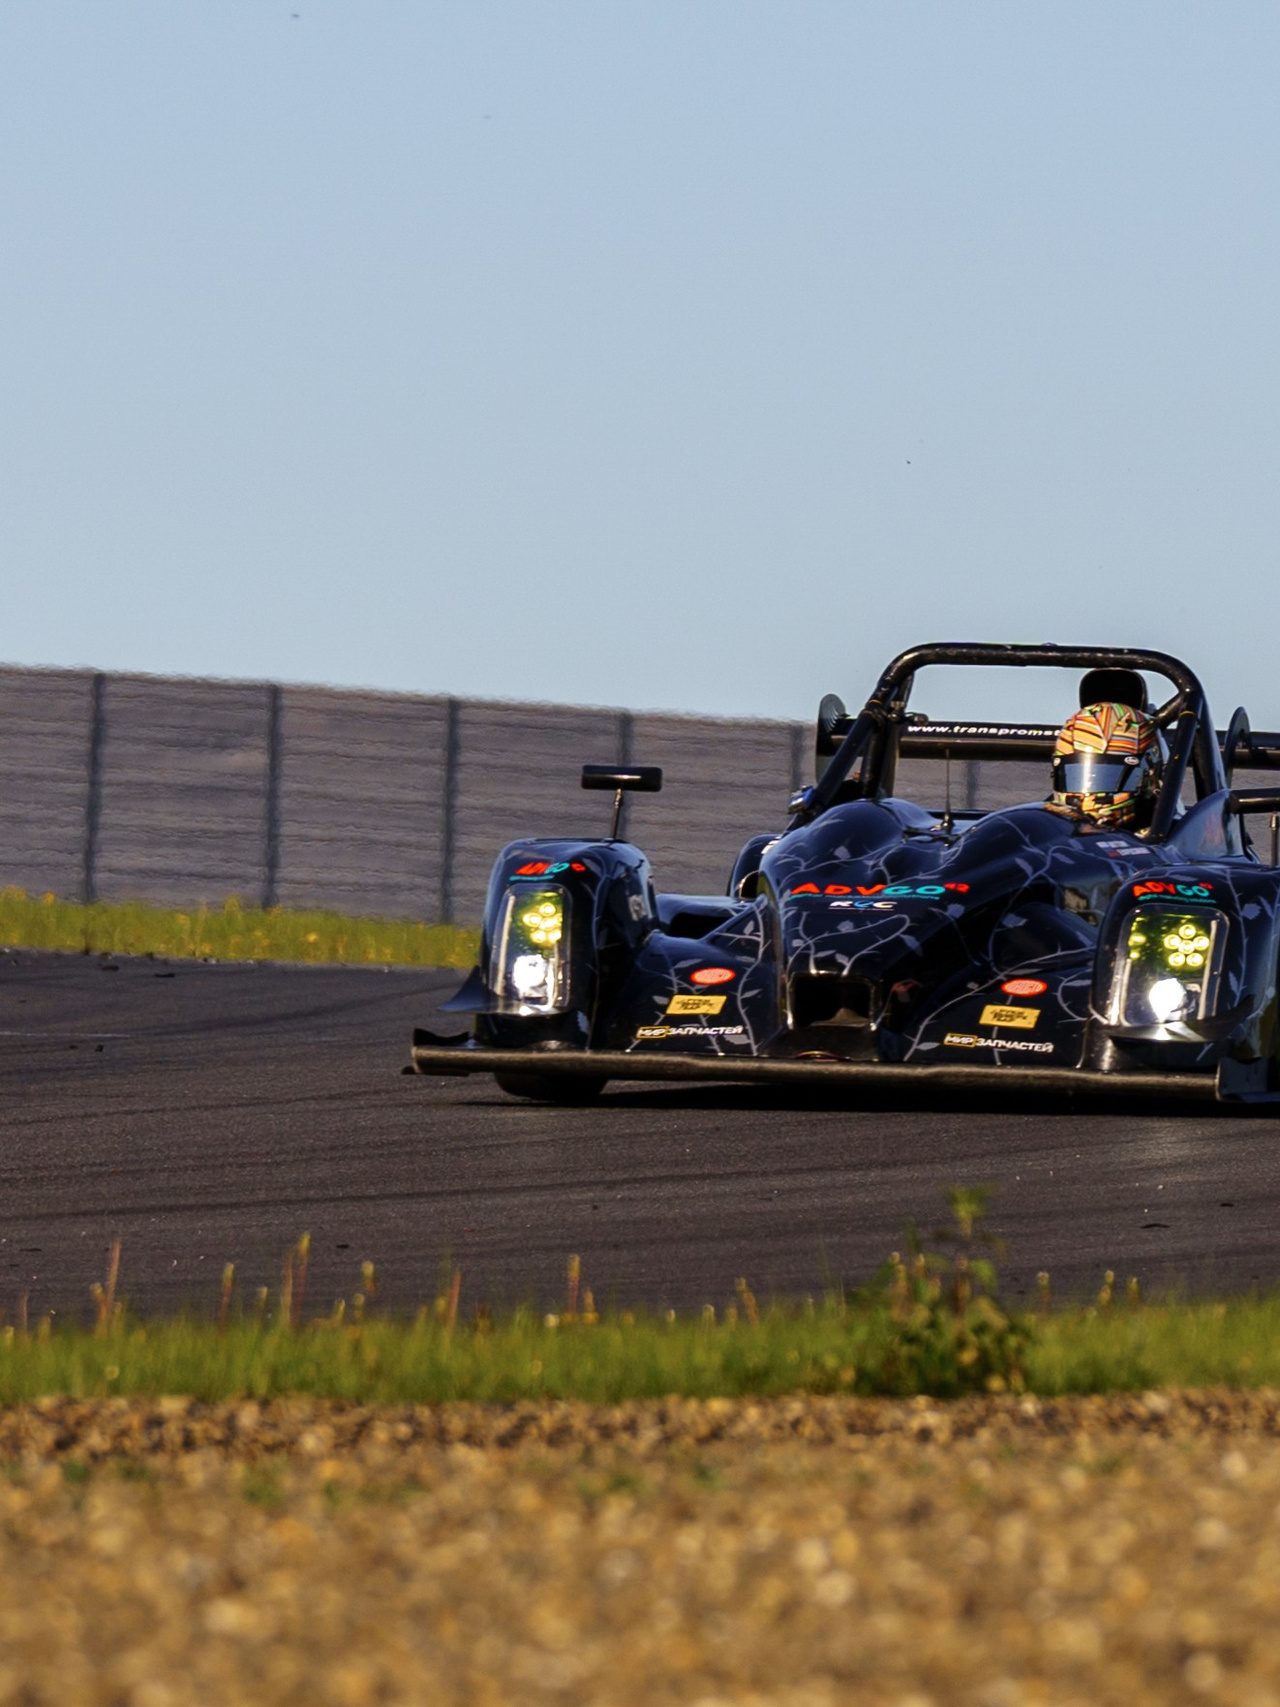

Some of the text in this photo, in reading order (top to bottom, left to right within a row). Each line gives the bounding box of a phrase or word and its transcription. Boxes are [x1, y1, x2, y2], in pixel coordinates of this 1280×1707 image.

[907, 725, 1062, 736] www.transpromst
[790, 882, 946, 896] ADVGO
[1133, 881, 1210, 897] ADVGO
